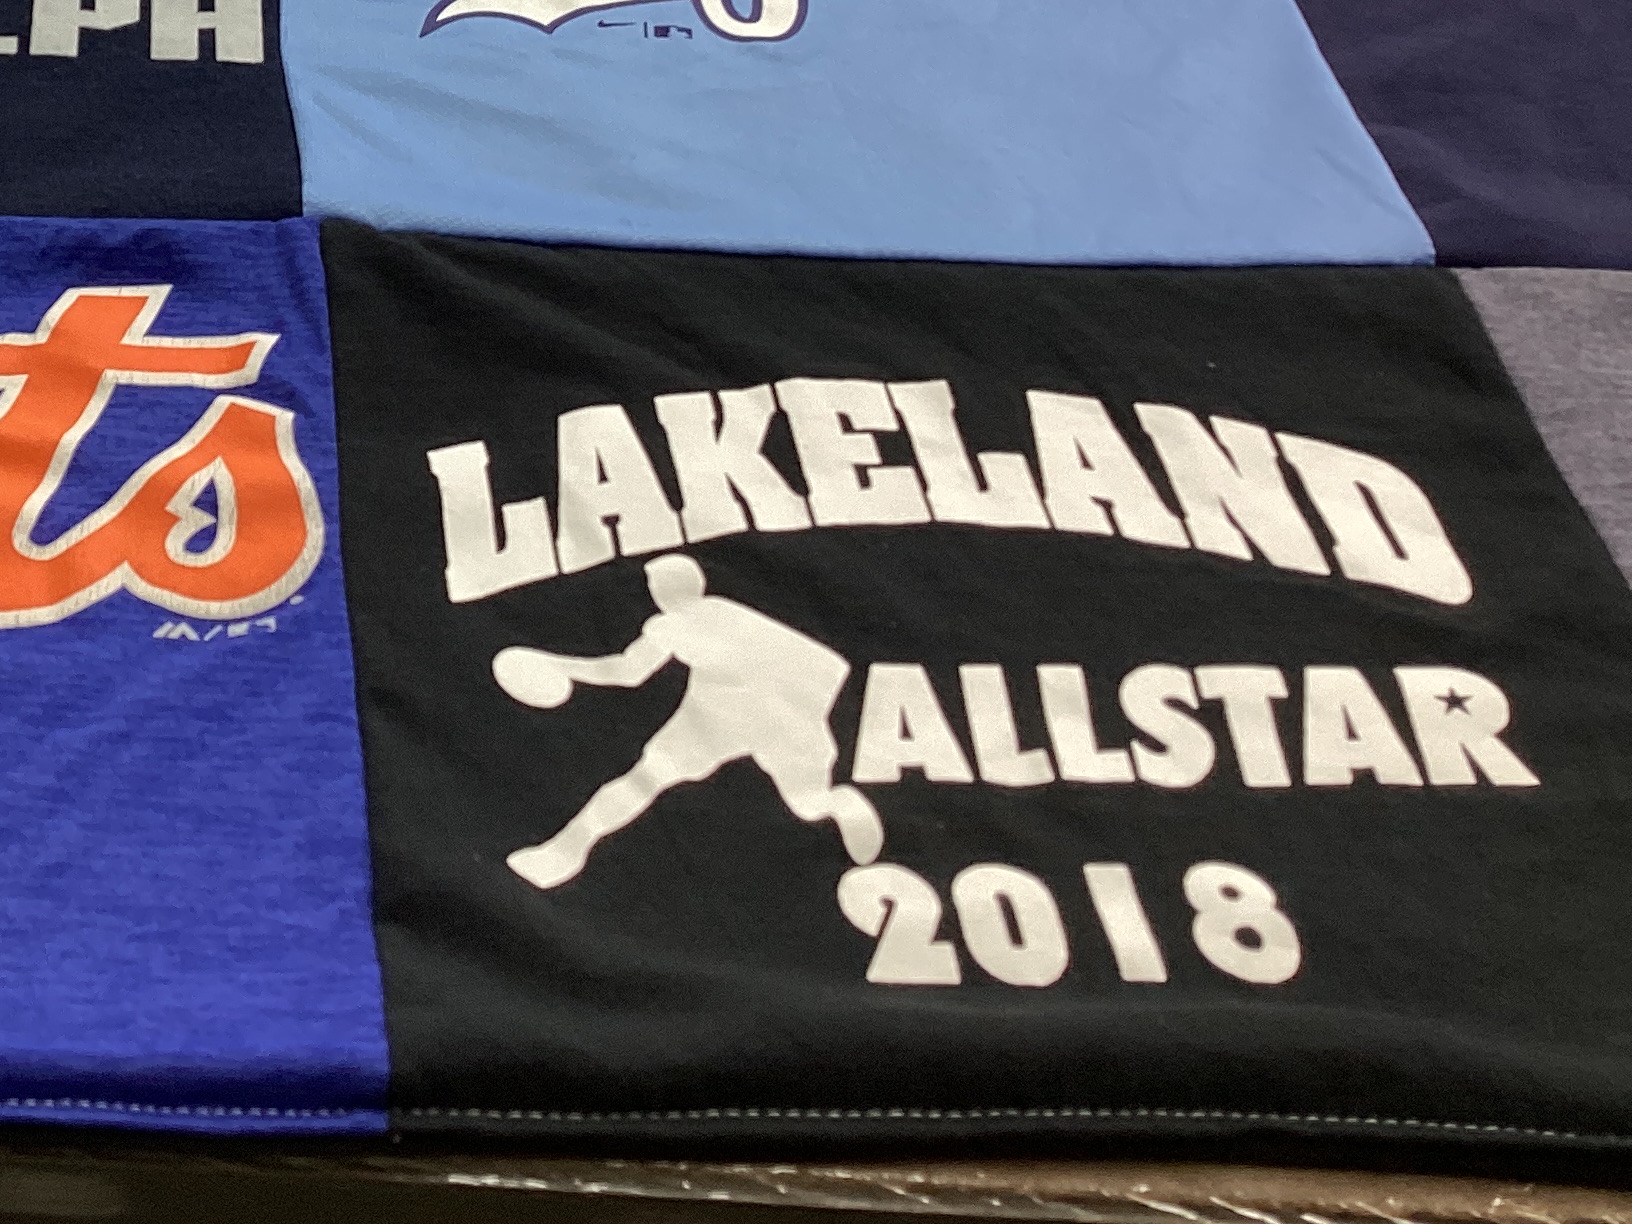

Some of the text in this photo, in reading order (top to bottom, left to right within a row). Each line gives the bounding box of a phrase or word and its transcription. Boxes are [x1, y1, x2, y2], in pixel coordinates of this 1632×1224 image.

[426, 376, 1474, 605] LAKELAND
[852, 662, 1542, 789] ALLSTAR
[836, 860, 1303, 987] 2018
